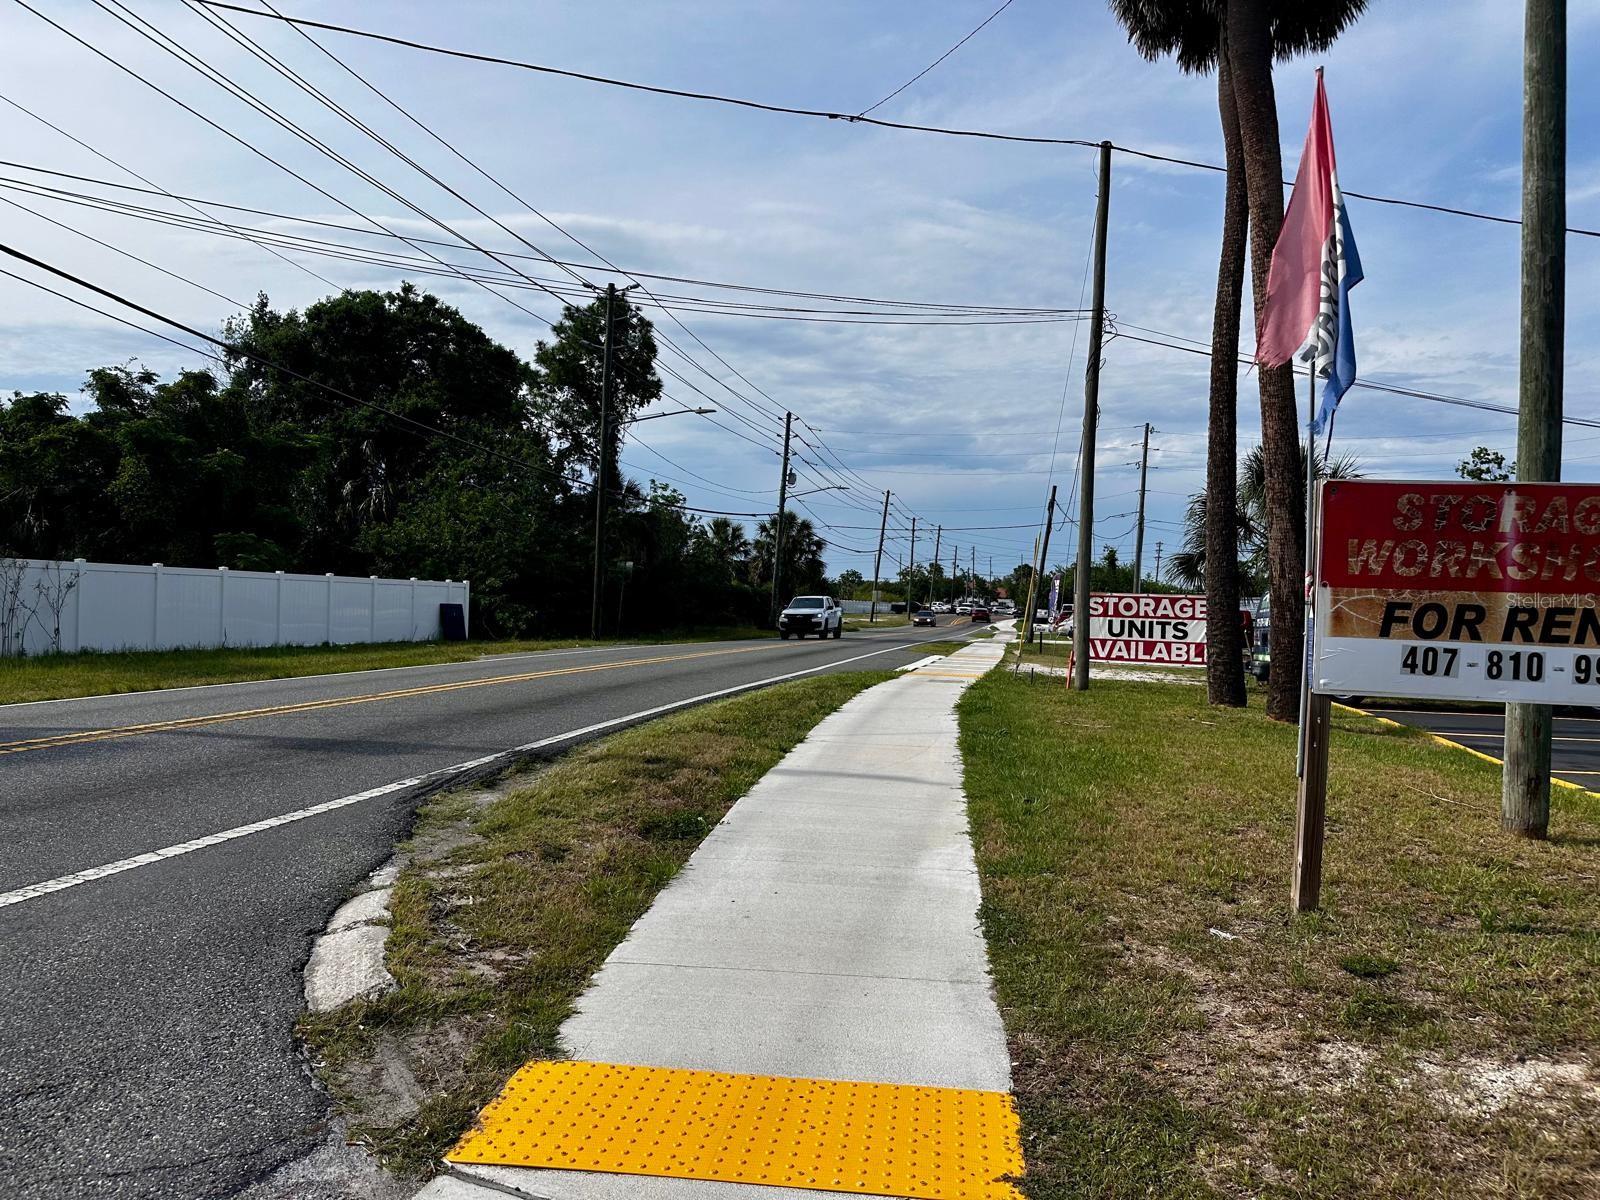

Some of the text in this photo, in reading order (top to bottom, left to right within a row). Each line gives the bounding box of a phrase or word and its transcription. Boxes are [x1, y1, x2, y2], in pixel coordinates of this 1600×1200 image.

[1089, 597, 1207, 618] STORAGE
[1107, 619, 1189, 640] UNITS
[1379, 601, 1486, 642] FOR
[1089, 640, 1207, 662] VAILABL
